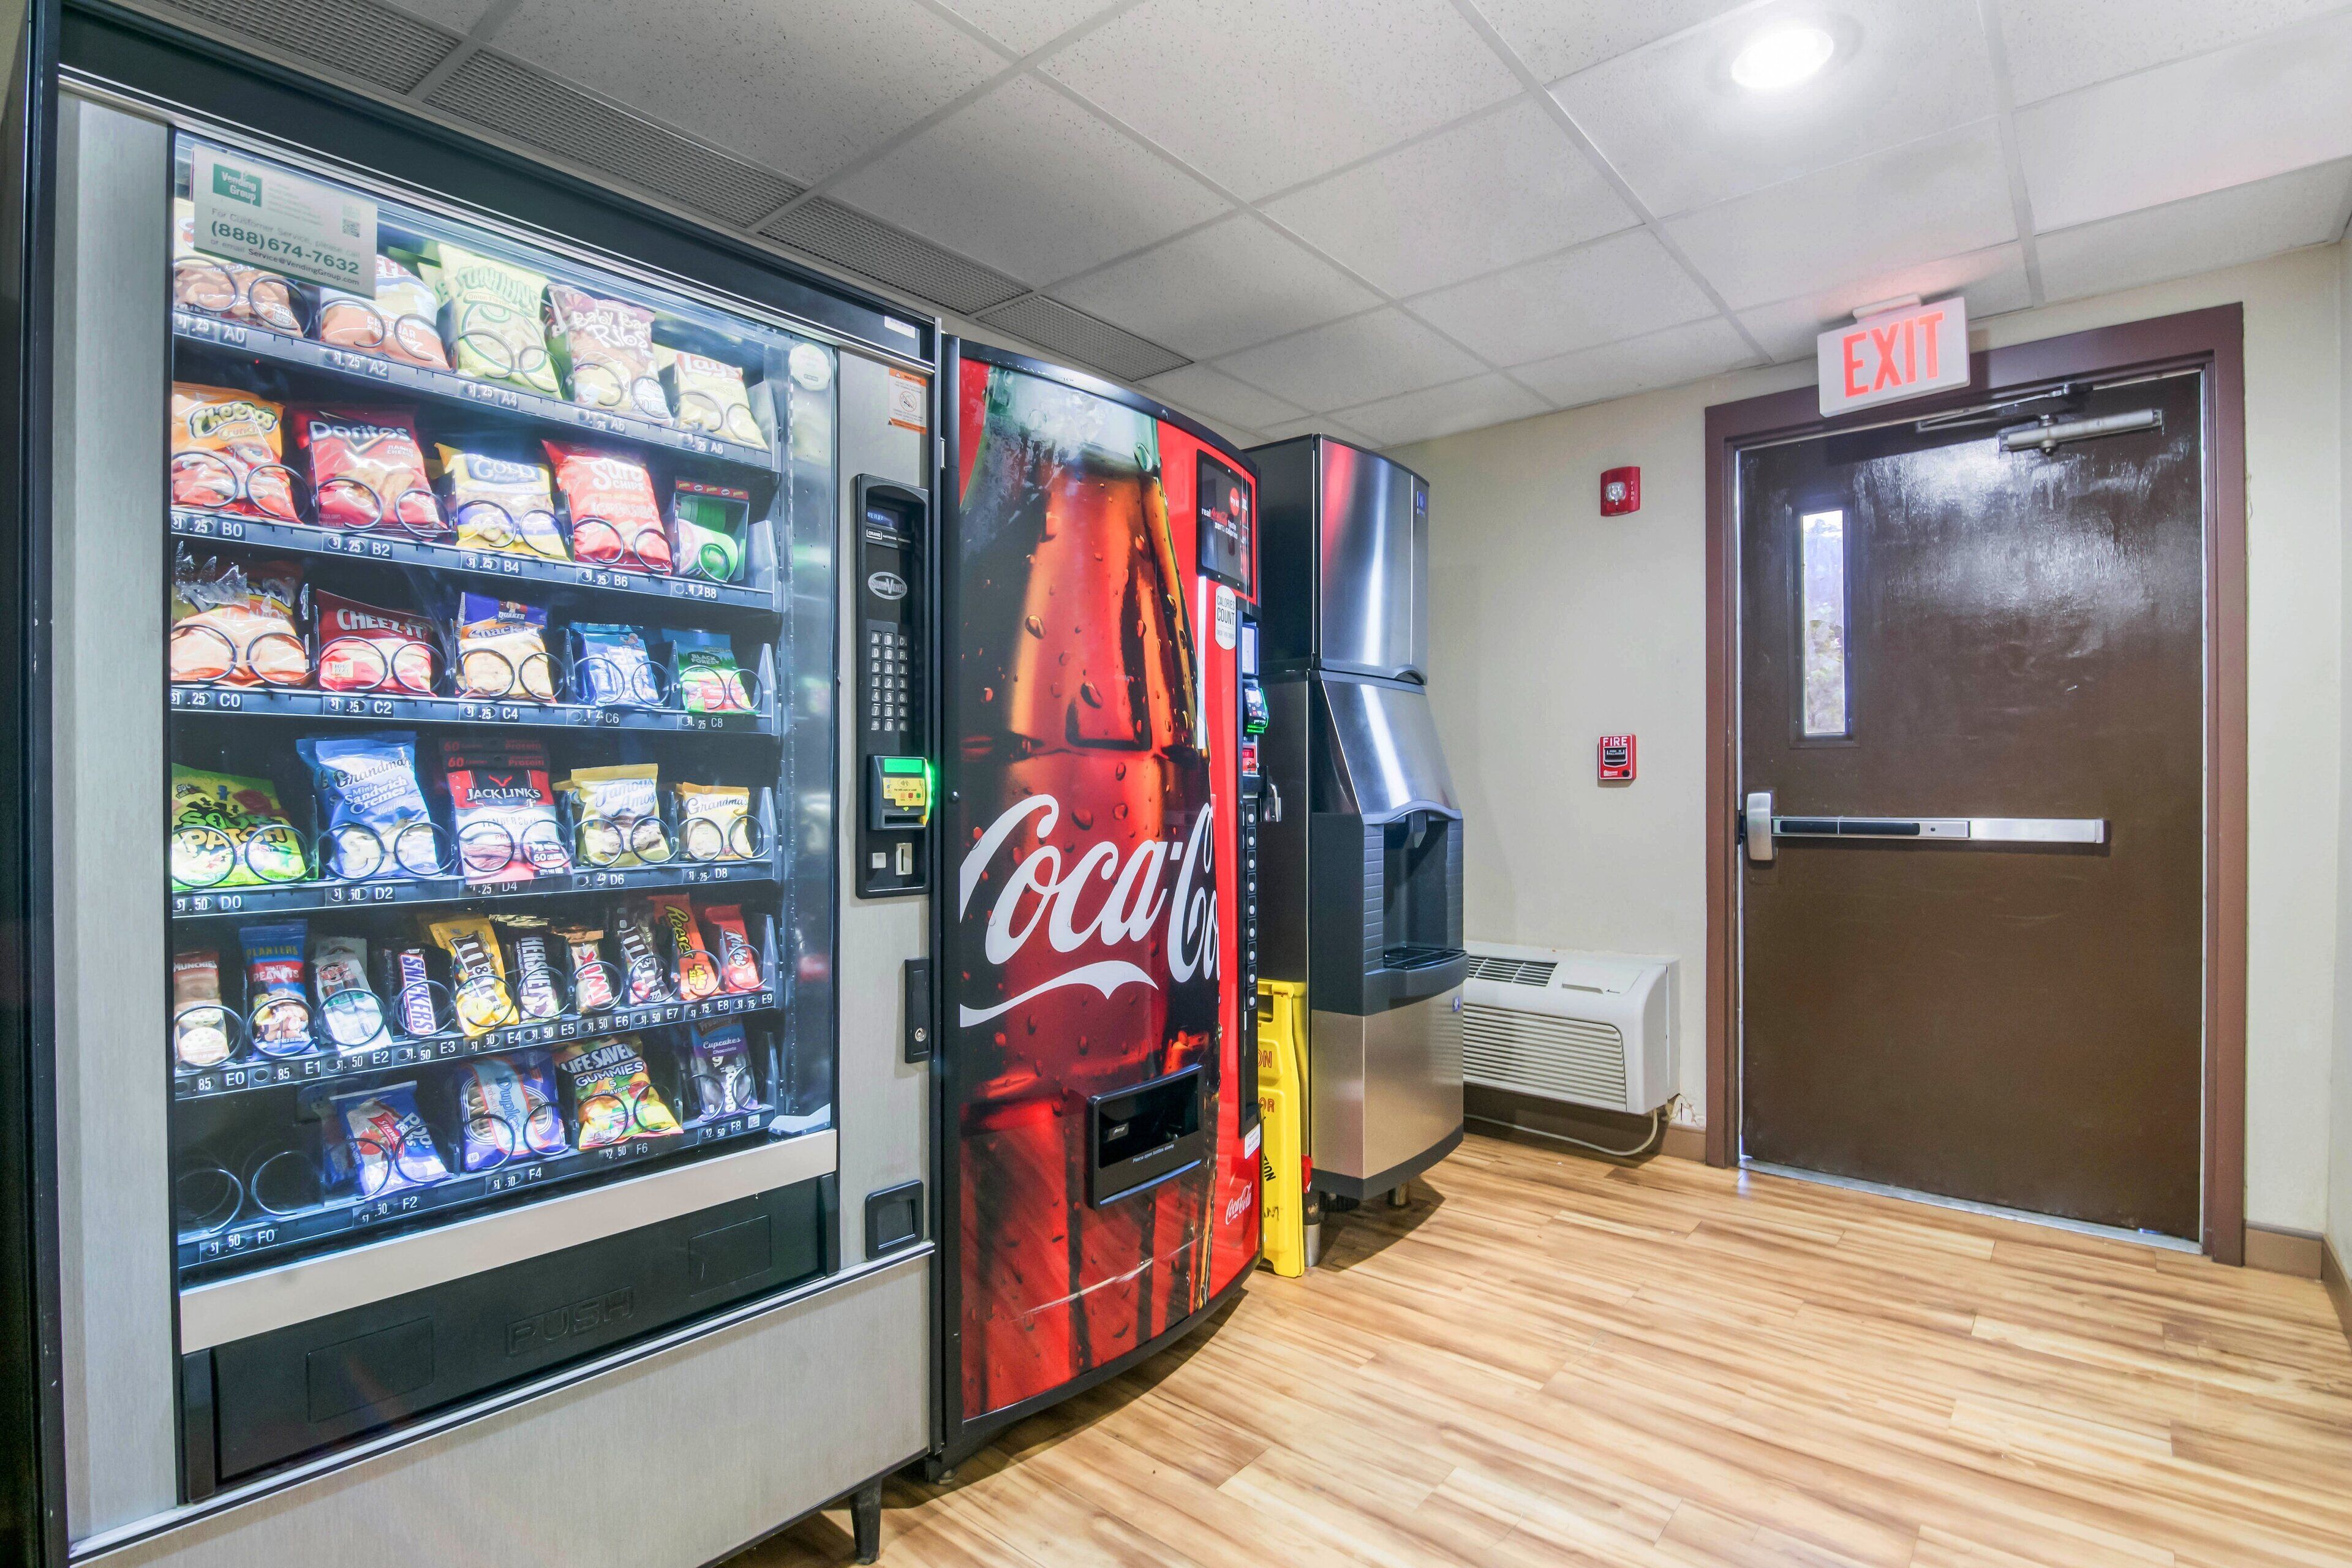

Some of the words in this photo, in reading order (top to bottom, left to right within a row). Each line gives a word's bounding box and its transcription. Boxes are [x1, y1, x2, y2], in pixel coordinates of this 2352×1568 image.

[221, 170, 257, 192] Vending
[229, 185, 256, 205] Group
[211, 208, 225, 217] For
[229, 214, 274, 233] Customer
[211, 221, 360, 275] (888)674-7632
[247, 248, 360, 286] Service@VendingGroup.com
[573, 310, 613, 330] Baby
[224, 328, 245, 344] A0
[586, 323, 649, 349] Ribs
[1842, 311, 1945, 398] EXIT
[369, 361, 387, 376] A2
[501, 392, 517, 407] A4
[309, 421, 412, 442] Doritos
[388, 445, 413, 454] NACHO
[473, 459, 536, 480] GOOD
[1201, 507, 1211, 518] real
[222, 522, 243, 538] B0
[372, 543, 390, 557] B2
[503, 560, 519, 573] B4
[614, 575, 628, 588] B6
[704, 587, 717, 599] B8
[1216, 595, 1235, 611] CALORIES
[337, 608, 404, 635] CHEEZ
[498, 611, 526, 620] QUAKER
[1217, 607, 1235, 625] COUNT
[873, 634, 878, 643] A
[887, 664, 892, 673] H
[900, 666, 903, 674] J
[219, 692, 241, 707] C0
[374, 700, 392, 714] C2
[502, 707, 519, 720] C4
[605, 713, 620, 724] C6
[711, 717, 723, 728] C8
[1602, 736, 1628, 747] FIRE
[448, 757, 464, 767] 60
[344, 775, 409, 805] Sandwich
[352, 784, 375, 796] Mini
[467, 788, 502, 801] JACK
[502, 787, 541, 799] LINK'S
[350, 786, 407, 814] Cremes
[621, 791, 656, 810] Amos
[180, 826, 287, 850] PATCH
[533, 853, 546, 862] 60
[610, 873, 625, 886] D6
[715, 868, 728, 878] D8
[375, 888, 393, 900] D2
[502, 882, 518, 892] D4
[221, 895, 242, 911] D0
[173, 960, 218, 973] MUNCHIES
[253, 967, 300, 982] PEANUTS
[402, 956, 434, 1031] SNICKERS
[761, 993, 773, 1005] E9
[717, 1000, 729, 1011] E8
[616, 1015, 629, 1027] E6
[666, 1008, 679, 1020] E7
[561, 1023, 575, 1036] E5
[508, 1031, 522, 1044] E4
[703, 1037, 742, 1049] Cupcakes
[440, 1040, 456, 1054] E3
[372, 1050, 389, 1065] E2
[560, 1054, 590, 1073] LIFE
[305, 1061, 321, 1075] E1
[576, 1061, 644, 1088] GUMMIES
[225, 1071, 245, 1087] E0
[600, 1084, 631, 1095] FLAVORS
[495, 1077, 521, 1133] Duplex
[731, 1120, 742, 1133] F8
[636, 1142, 649, 1155] F6
[529, 1166, 543, 1181] F4
[402, 1196, 418, 1210] F2
[258, 1229, 275, 1245] F0
[511, 1287, 633, 1352] PUSH
